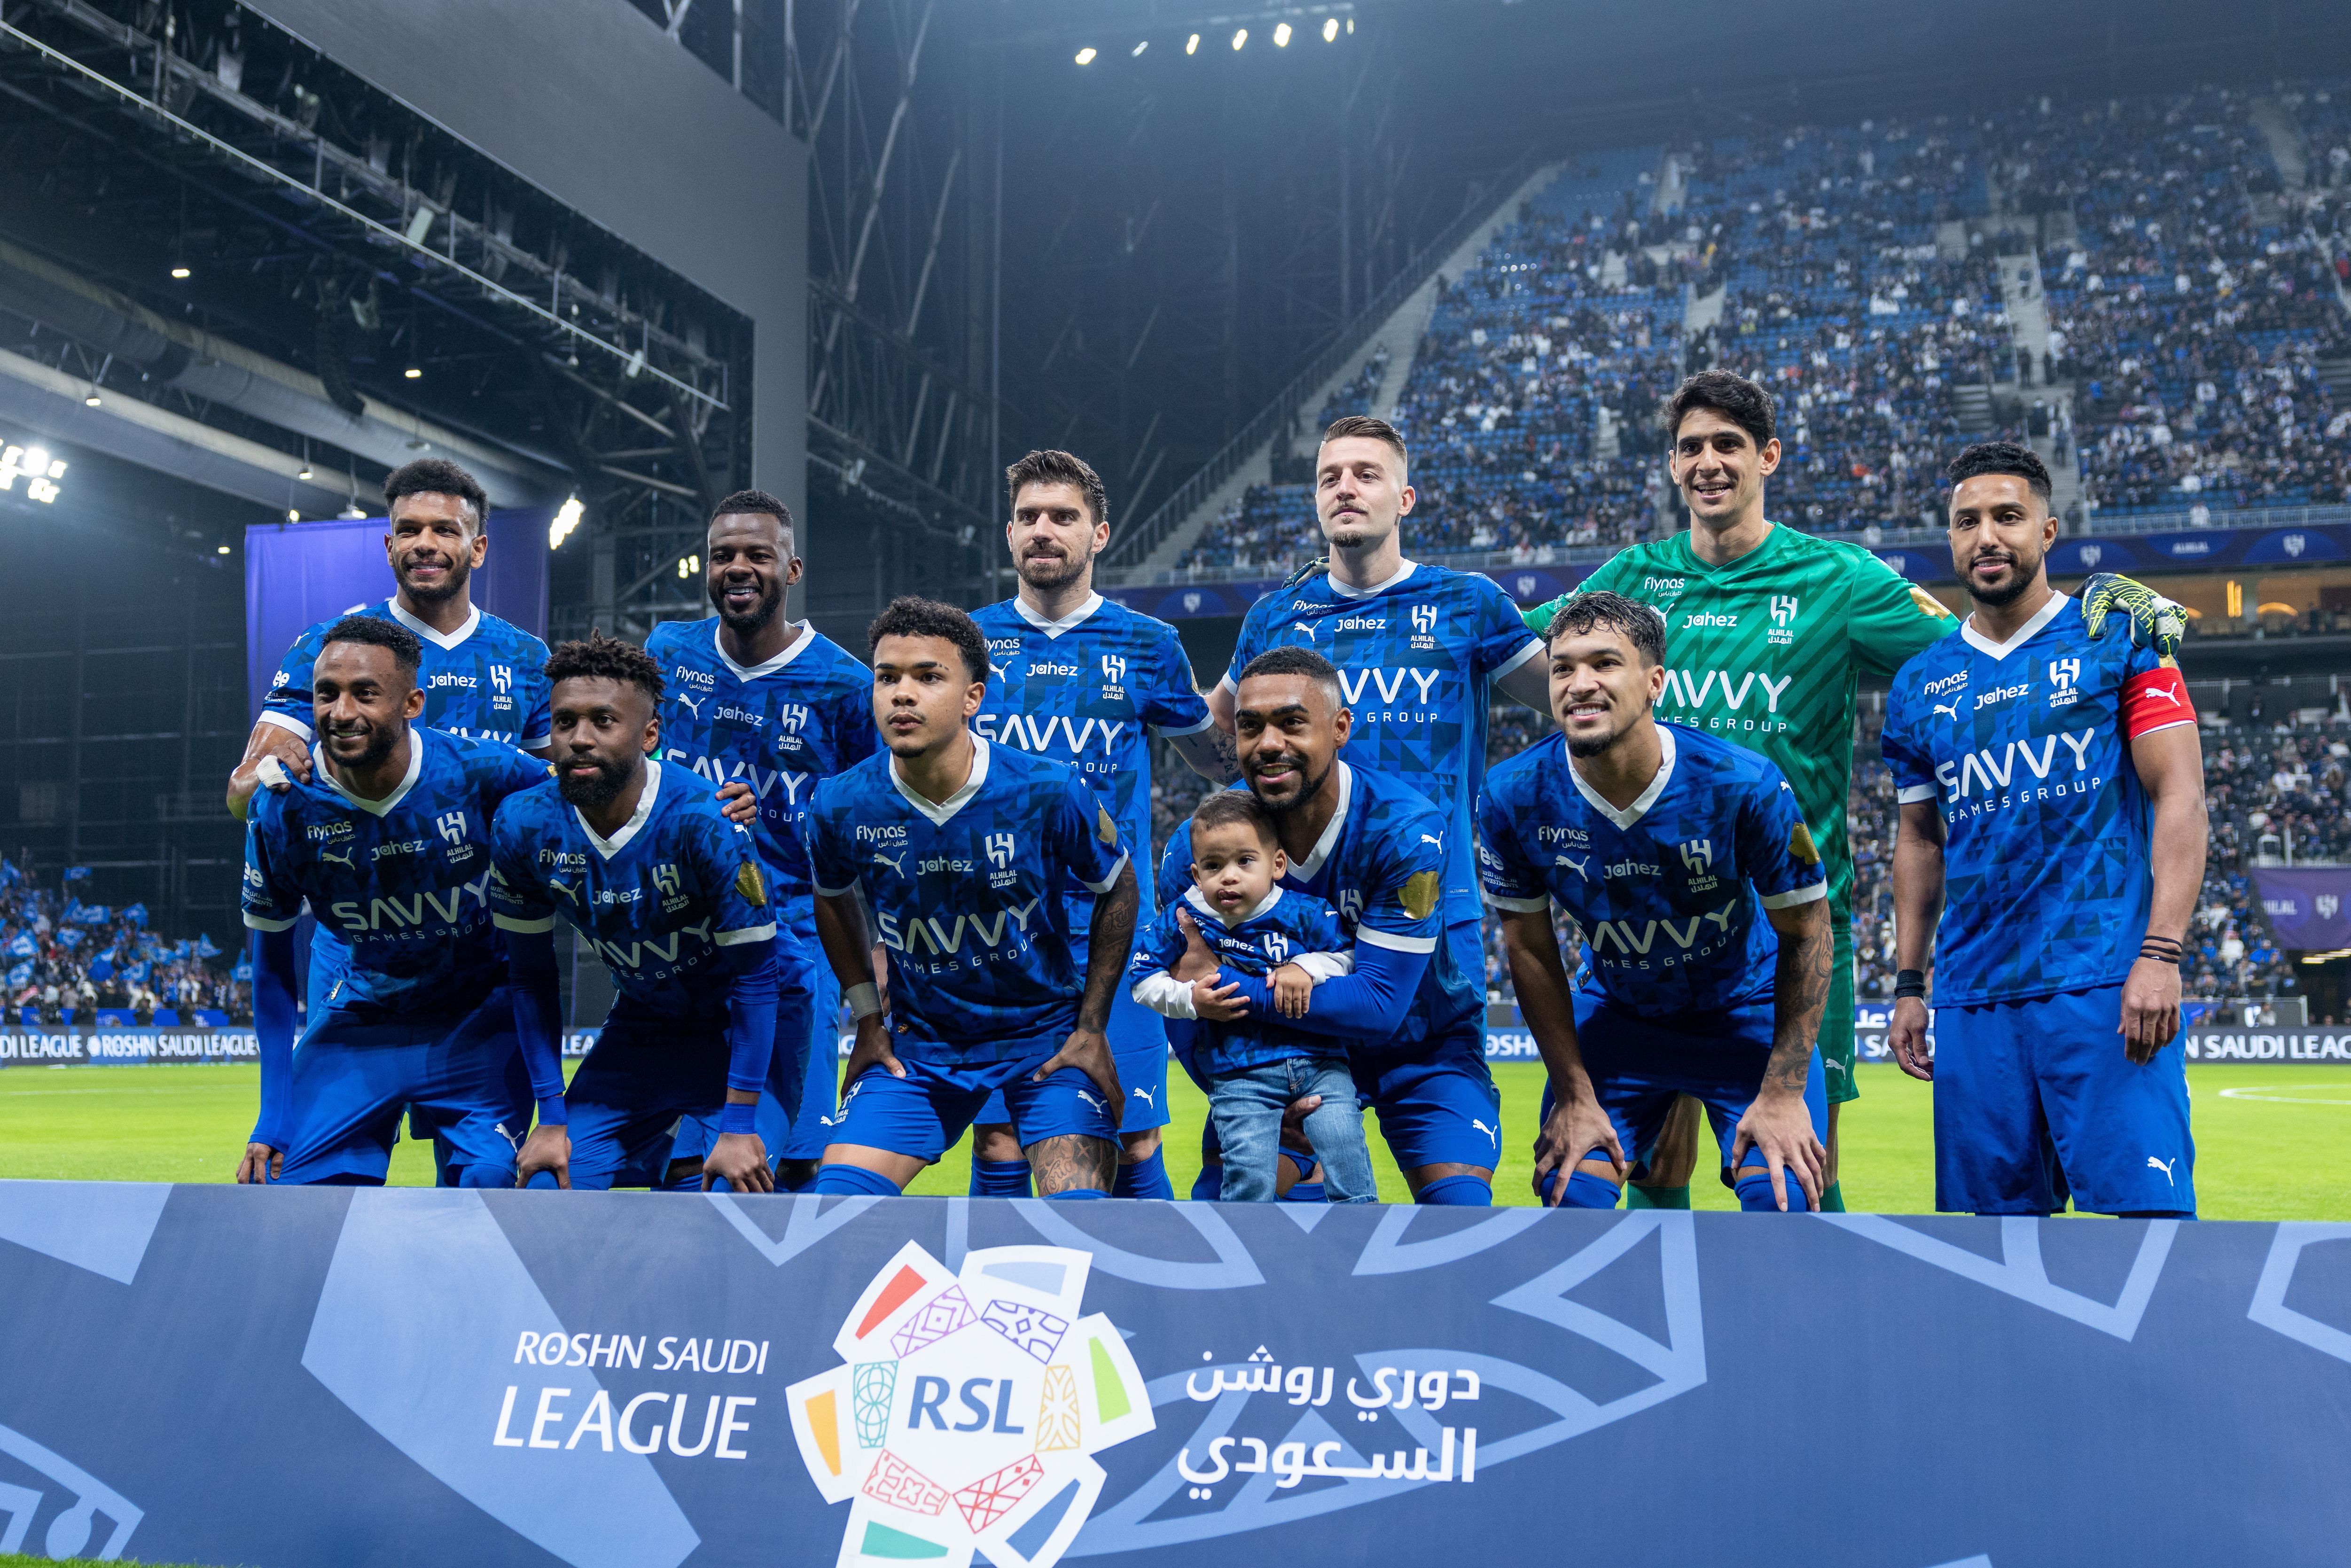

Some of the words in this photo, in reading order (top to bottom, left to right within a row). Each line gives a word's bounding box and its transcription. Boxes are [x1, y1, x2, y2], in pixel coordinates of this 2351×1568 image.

[1644, 577, 1685, 592] flynas
[984, 638, 1020, 652] ynas
[1767, 628, 1794, 637] ALHILAL
[676, 666, 714, 685] flynas
[1337, 667, 1439, 704] VVY
[1924, 670, 1968, 695] flynas
[1102, 685, 1125, 694] ALHILAL
[1656, 669, 1792, 713] AVVY
[2049, 686, 2078, 700] ALHILAL
[1367, 711, 1438, 723] GROUP
[1710, 718, 1787, 733] GROUP
[778, 735, 803, 744] ALHILAL
[975, 713, 1125, 756] SAVVY
[1935, 727, 2095, 803] SAVVY
[1948, 796, 2011, 823] GAMES
[2021, 777, 2101, 803] GROUP
[307, 821, 352, 840] flynas
[856, 825, 906, 842] flynas
[1538, 826, 1588, 842] flynas
[447, 843, 474, 857] ALHILAL
[539, 849, 586, 866] flynas
[990, 869, 1017, 880] ALHILAL
[1688, 874, 1718, 885] ALHILAL
[331, 869, 490, 931] SAVVY
[662, 895, 689, 906] ALHILAL
[353, 930, 426, 943] GAMES
[435, 909, 493, 938] GROU
[877, 898, 1039, 956] SAVVY
[1592, 898, 1736, 954] AVVY
[593, 915, 711, 968] AVVY
[972, 932, 1039, 967] GROUP
[1602, 959, 1650, 969] MES
[1664, 925, 1739, 967] GROUP
[655, 946, 712, 980] GROU
[21, 1035, 83, 1057] LEAGUE
[102, 1035, 158, 1056] ROSHN
[158, 1035, 203, 1056] SAUDI
[205, 1035, 257, 1056] LEAGUE
[2204, 1035, 2285, 1059] SAUDI
[2289, 1035, 2351, 1059] LEAG
[514, 1331, 647, 1368] ROSHN
[652, 1336, 769, 1374] SAUDI
[1186, 1344, 1335, 1407] روشن
[907, 1375, 1024, 1435] RSL
[1346, 1366, 1480, 1422] دوري
[492, 1385, 757, 1459] LEAGUE
[1177, 1427, 1477, 1501] السعودي
